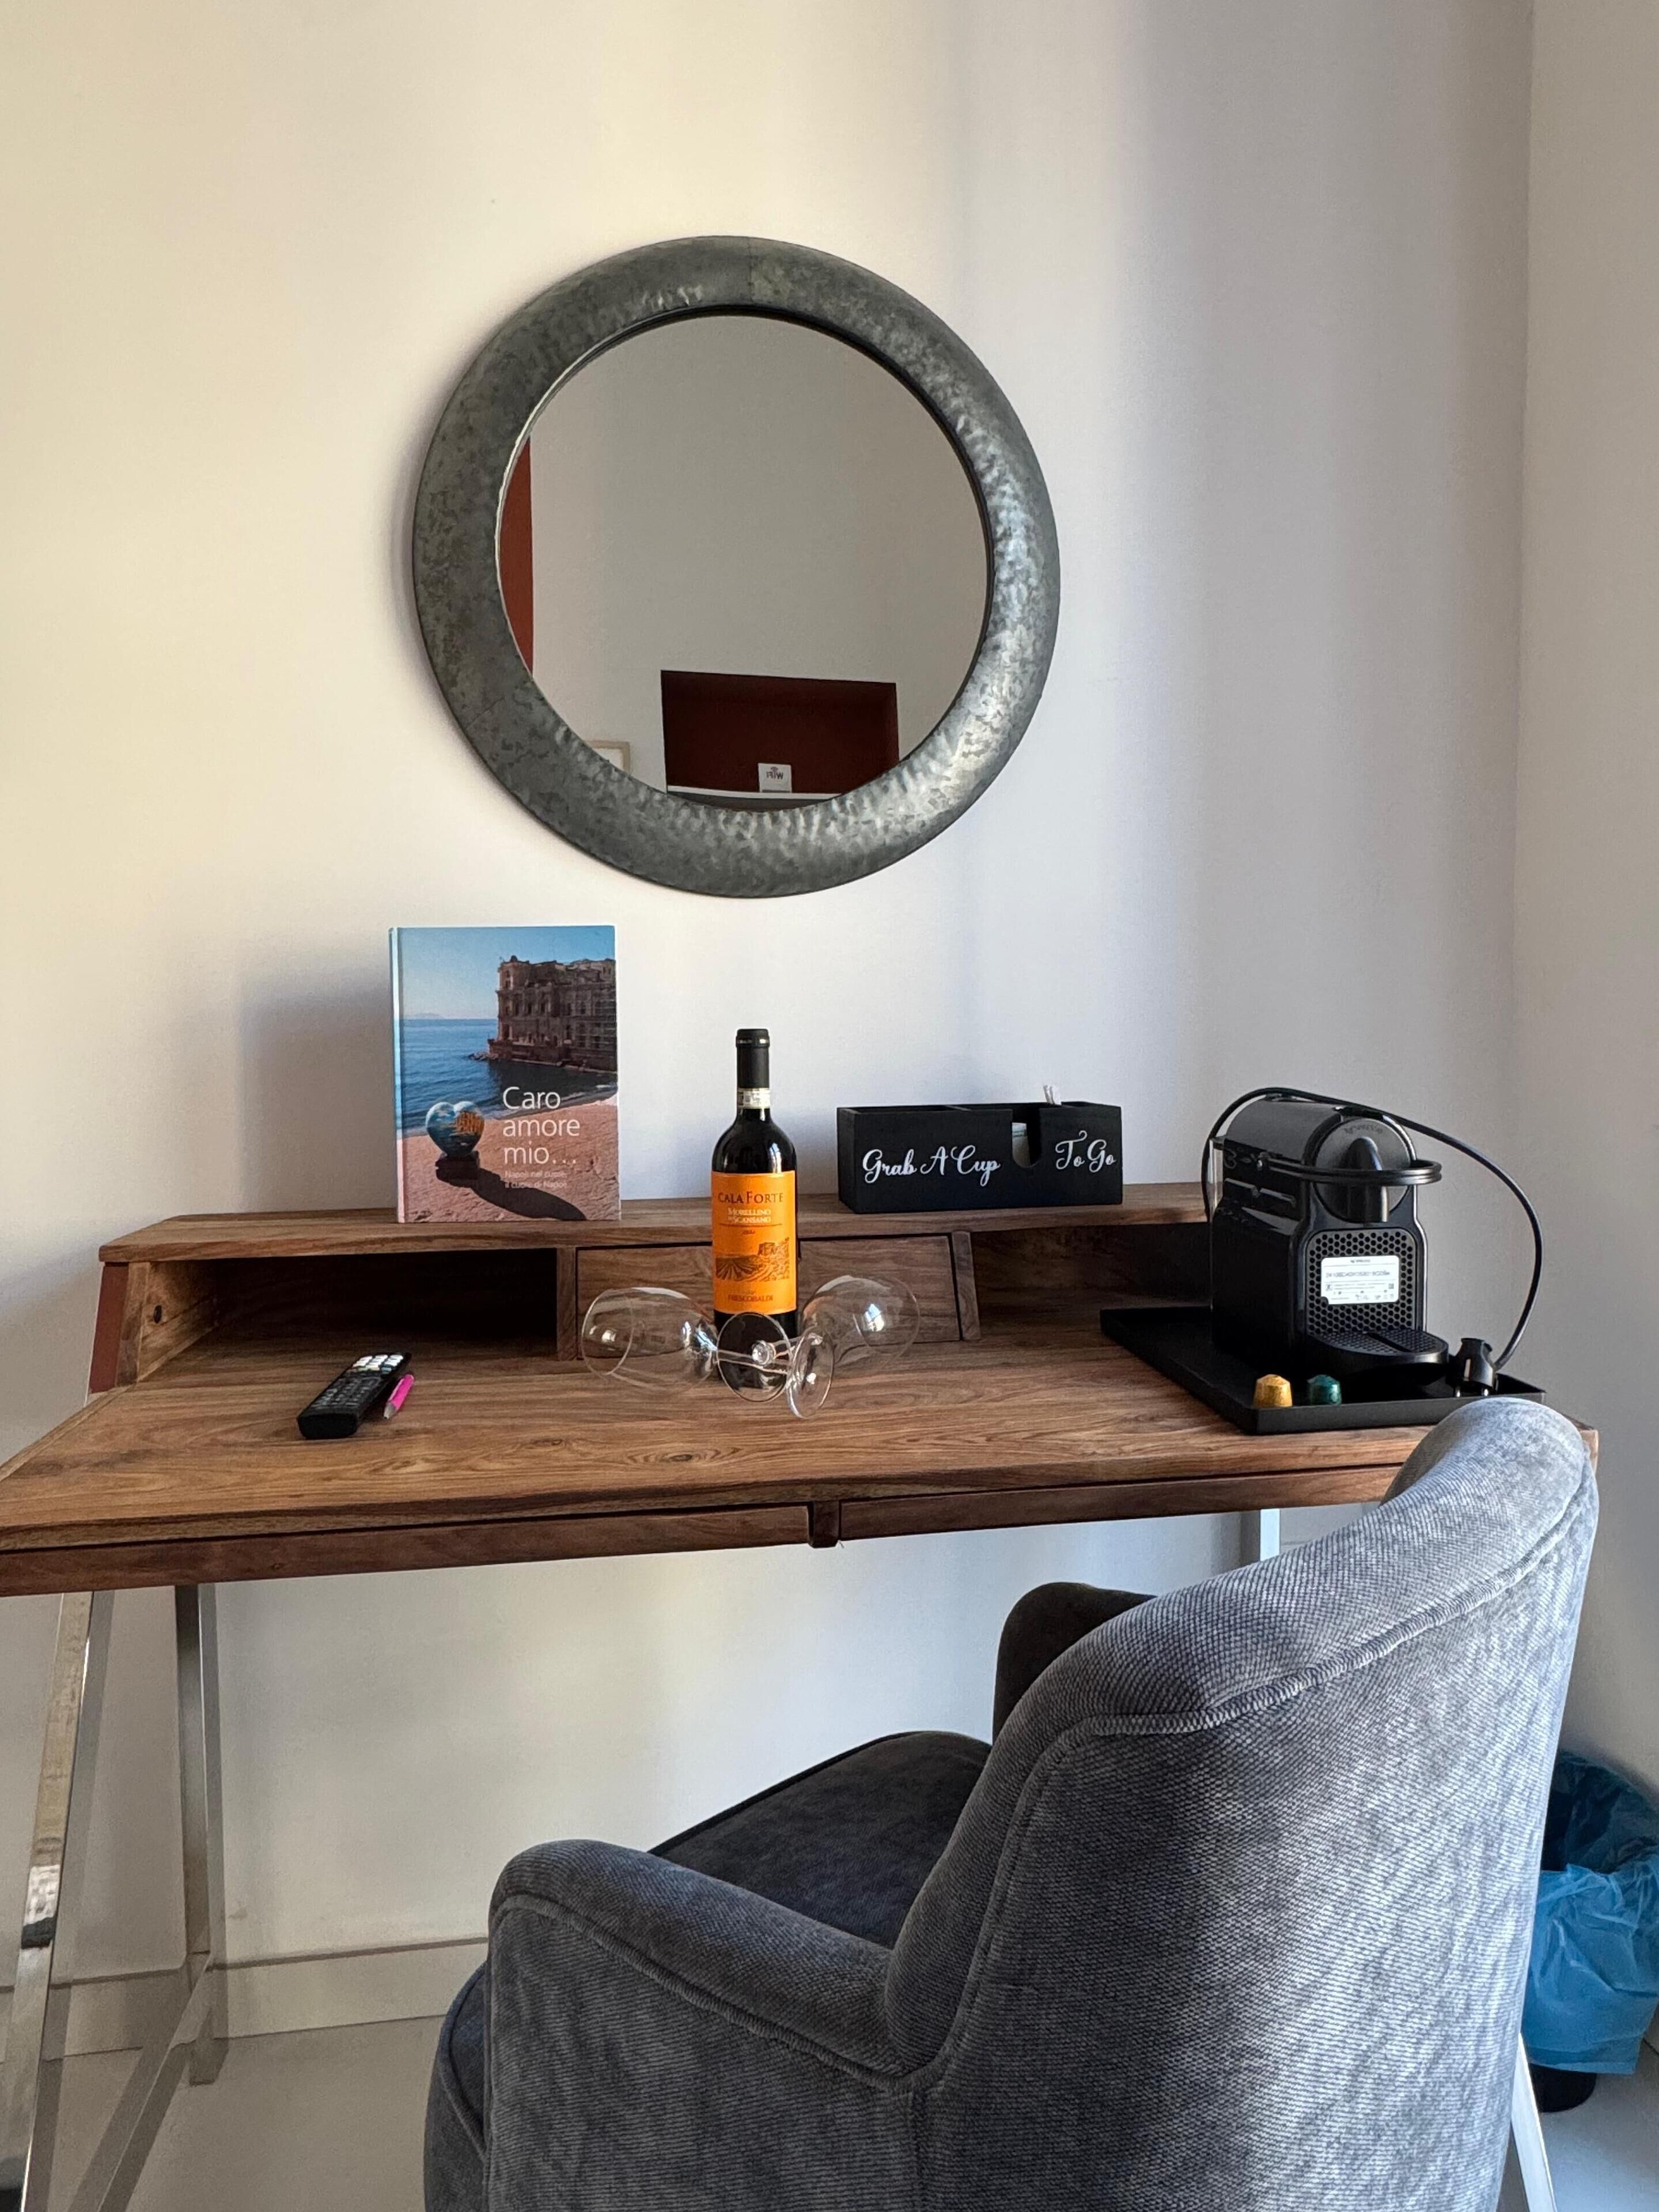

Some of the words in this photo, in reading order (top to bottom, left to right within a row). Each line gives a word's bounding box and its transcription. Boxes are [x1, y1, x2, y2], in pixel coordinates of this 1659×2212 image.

[502, 1086, 561, 1109] Caro
[502, 1119, 581, 1137] amore
[503, 1140, 577, 1165] mio...
[1055, 1130, 1088, 1170] To
[1086, 1139, 1116, 1173] Go
[862, 1149, 918, 1184] Grab
[920, 1146, 949, 1176] A
[950, 1145, 1001, 1187] Cup
[718, 1192, 744, 1204] CALA
[746, 1191, 784, 1204] FORTE
